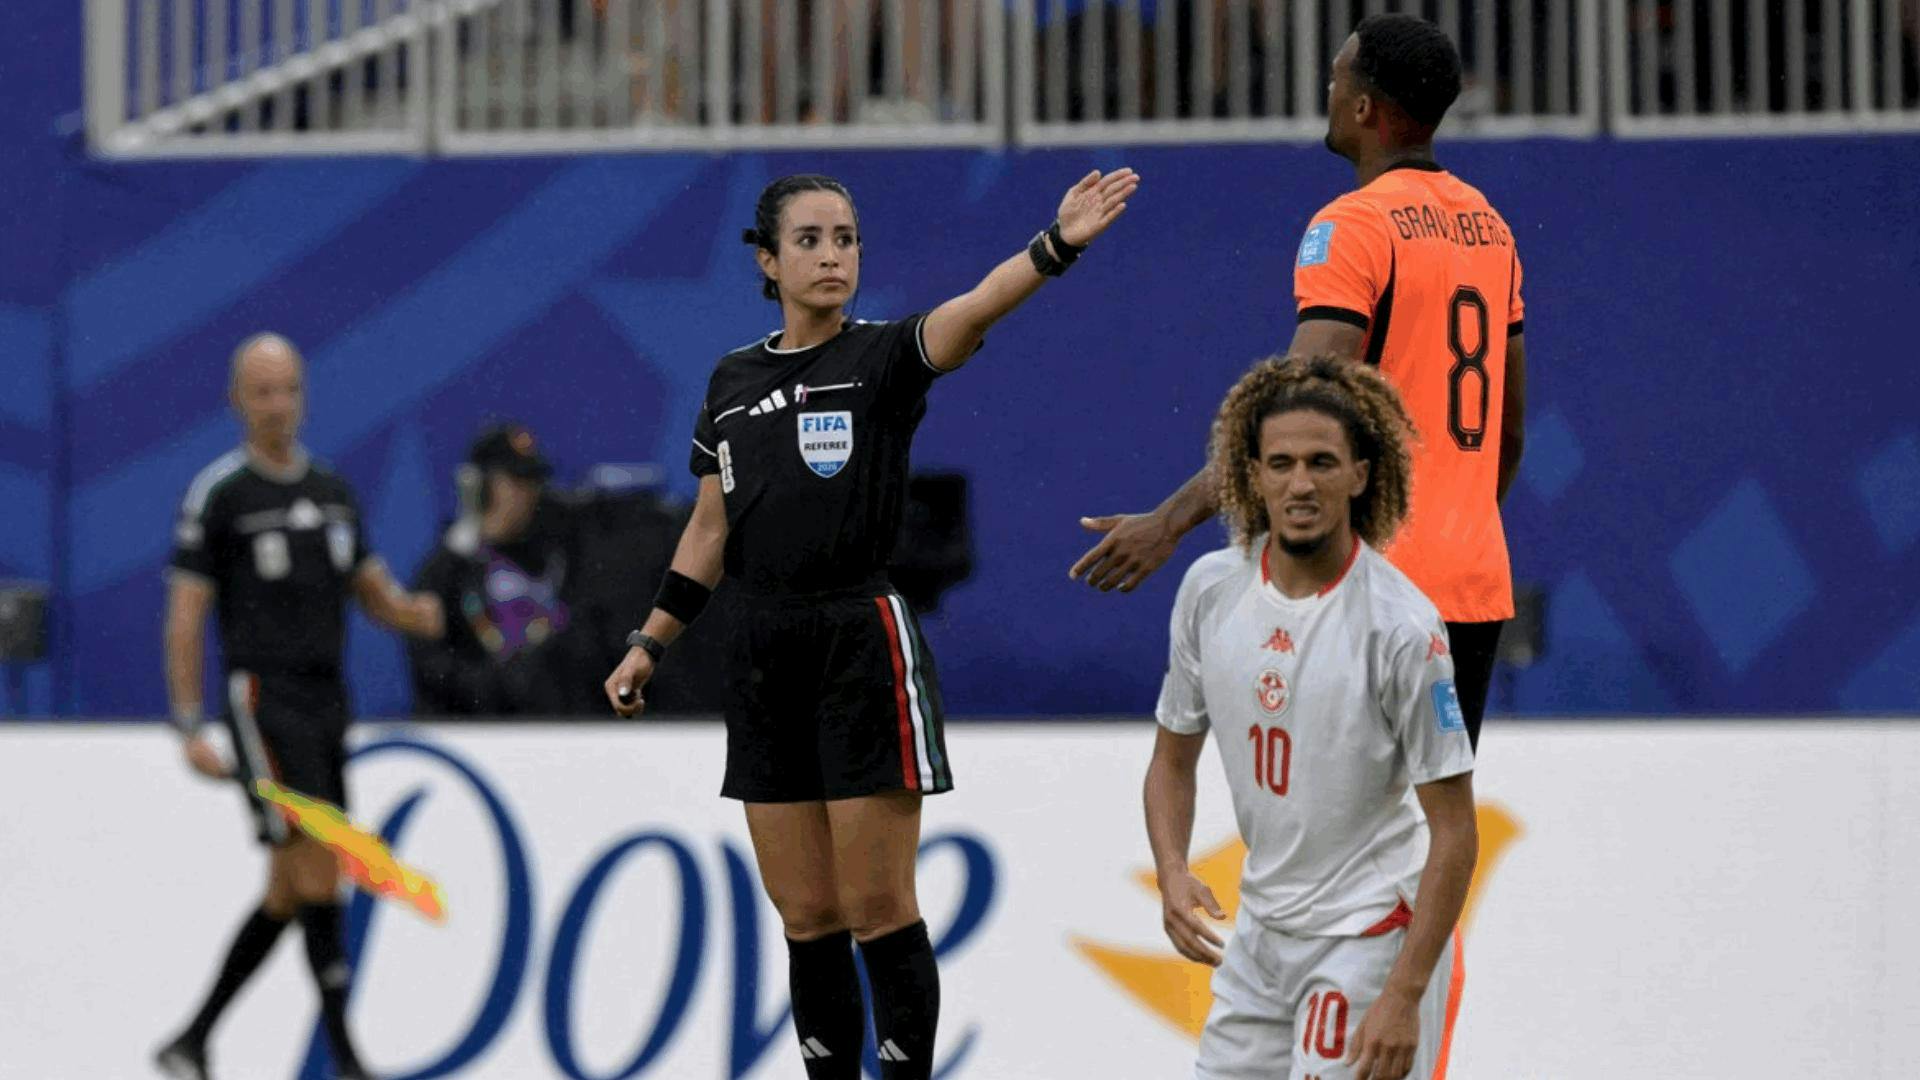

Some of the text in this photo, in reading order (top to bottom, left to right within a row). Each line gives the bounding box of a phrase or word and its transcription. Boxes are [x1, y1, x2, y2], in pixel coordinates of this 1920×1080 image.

[1447, 285, 1489, 451] 8
[803, 416, 848, 432] FIFA
[804, 441, 848, 451] REFEREE
[1248, 723, 1291, 797] 10
[1302, 990, 1349, 1060] 10
